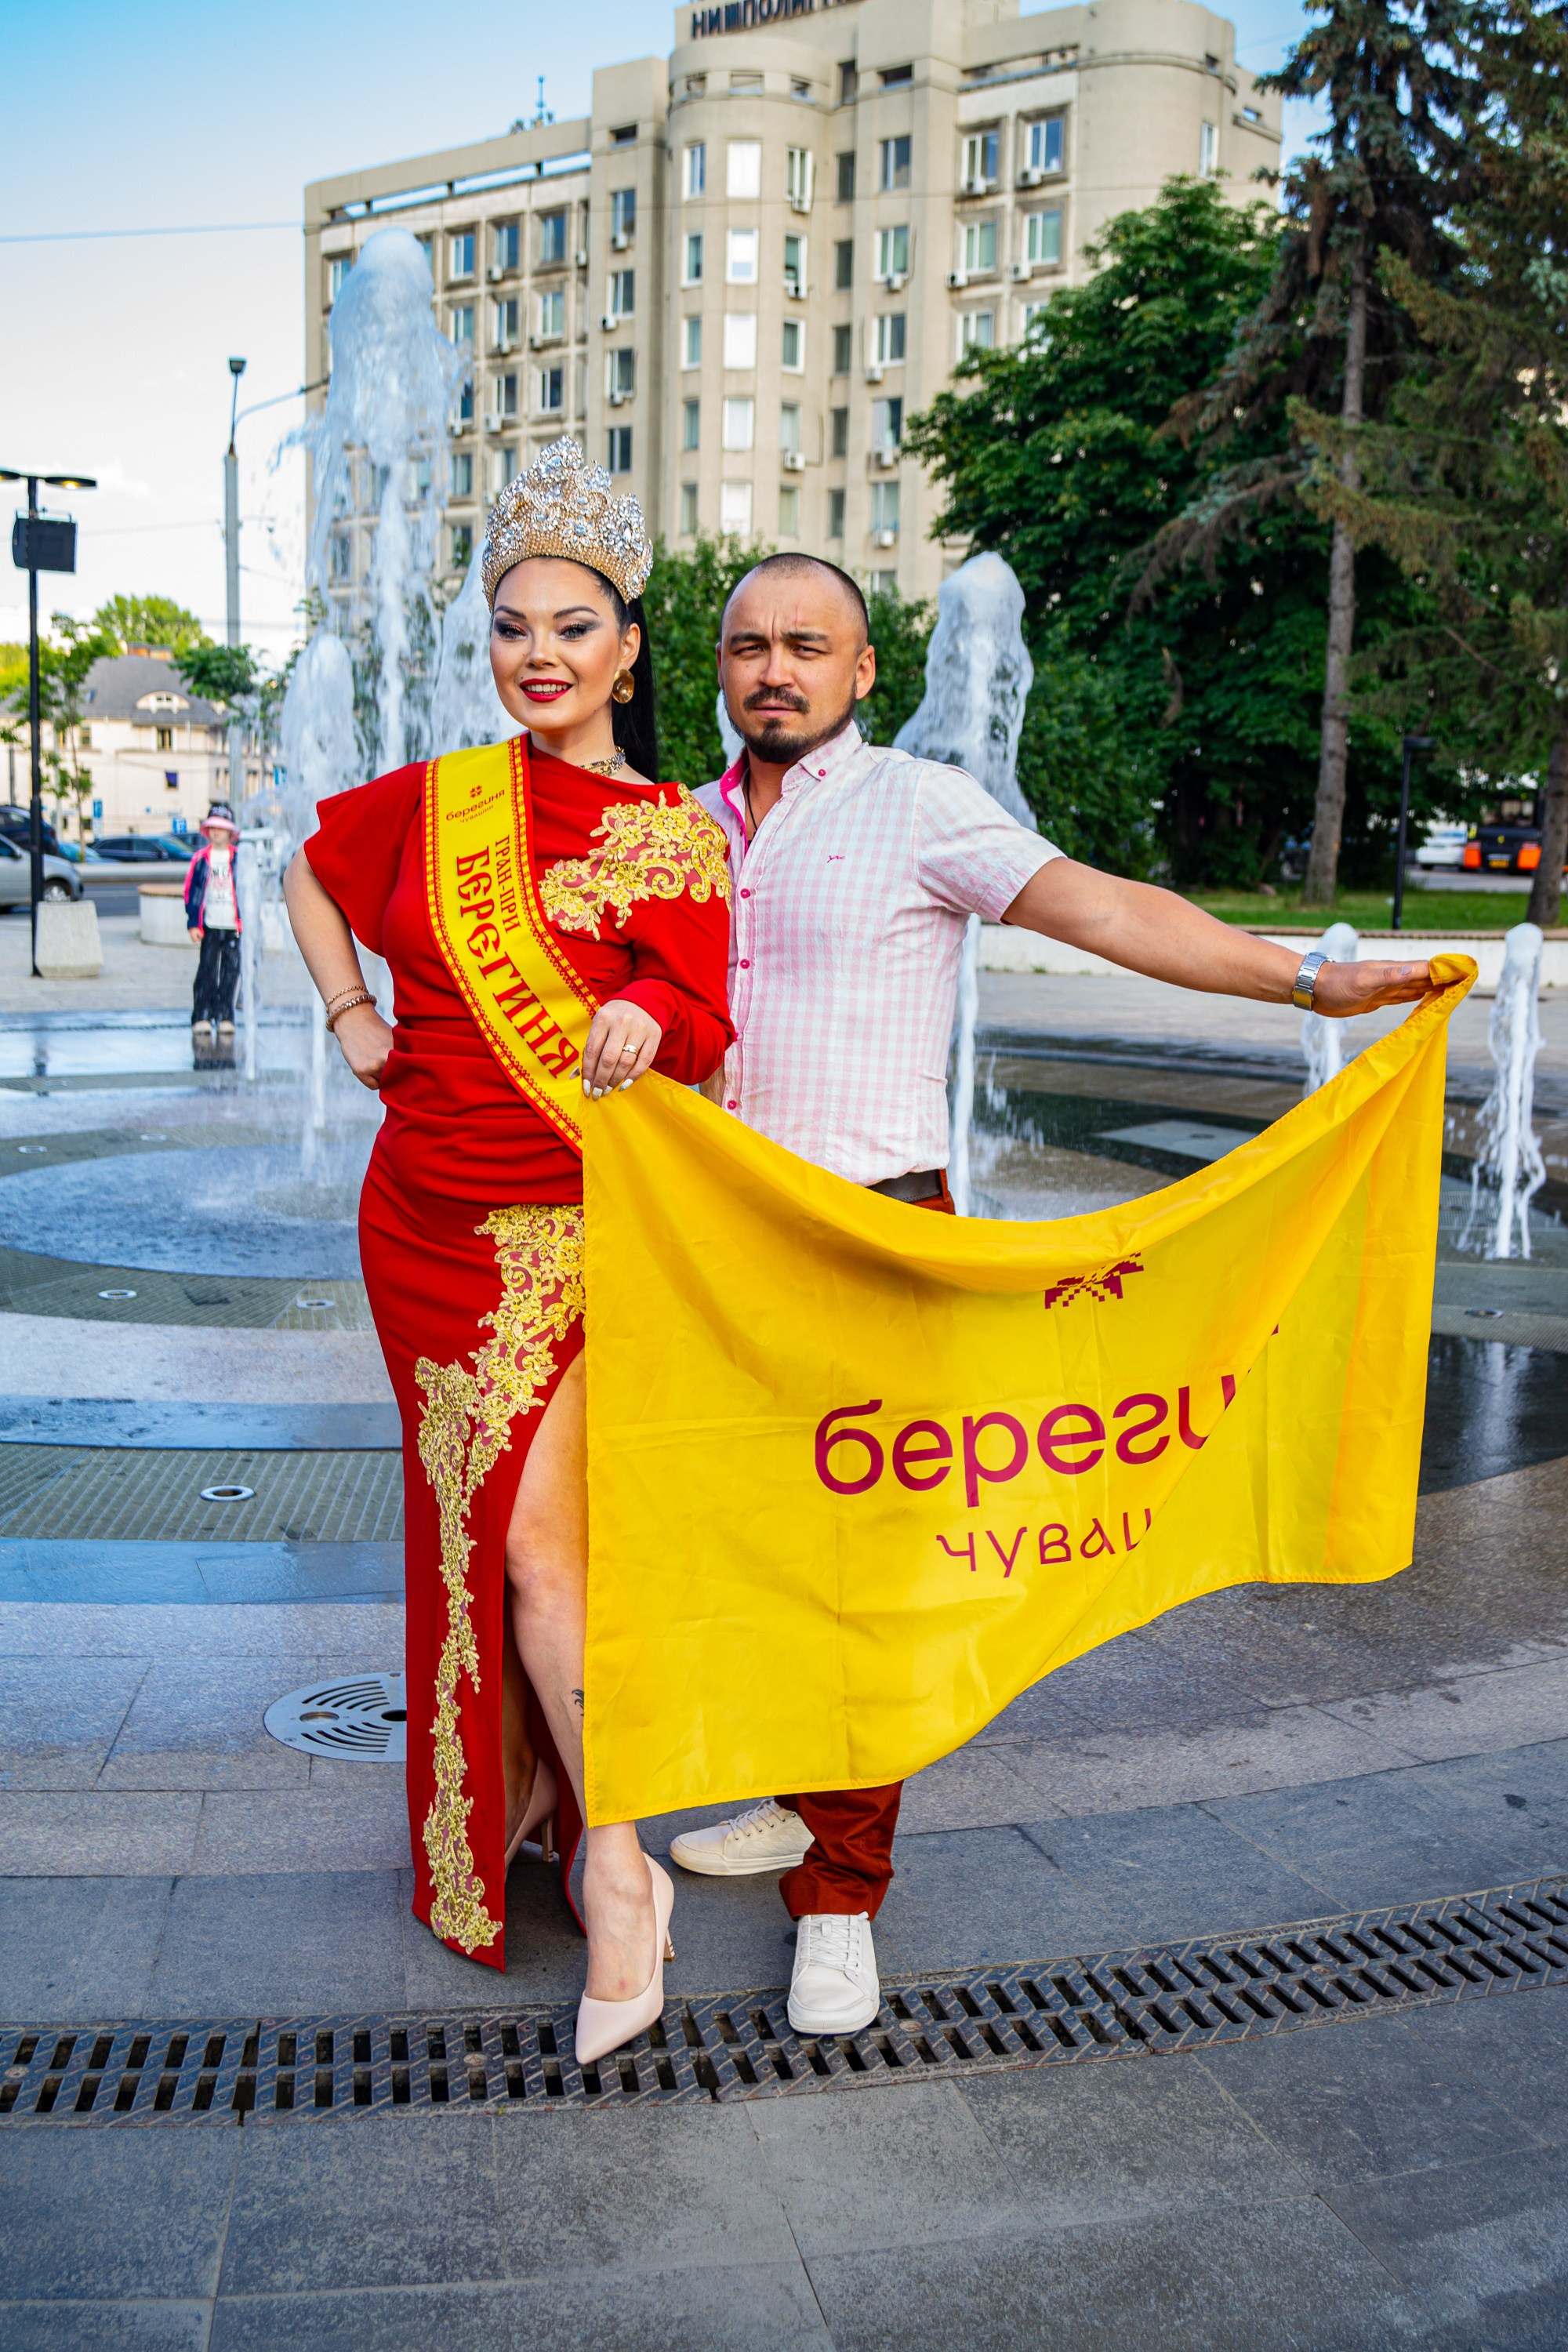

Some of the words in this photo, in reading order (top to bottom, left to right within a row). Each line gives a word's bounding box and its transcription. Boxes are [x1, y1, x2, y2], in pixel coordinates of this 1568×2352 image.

[495, 834, 521, 934] ГРАН-ПРИ
[456, 846, 579, 1079] БЕРЕГИНЯ
[815, 1372, 1240, 1508] береги
